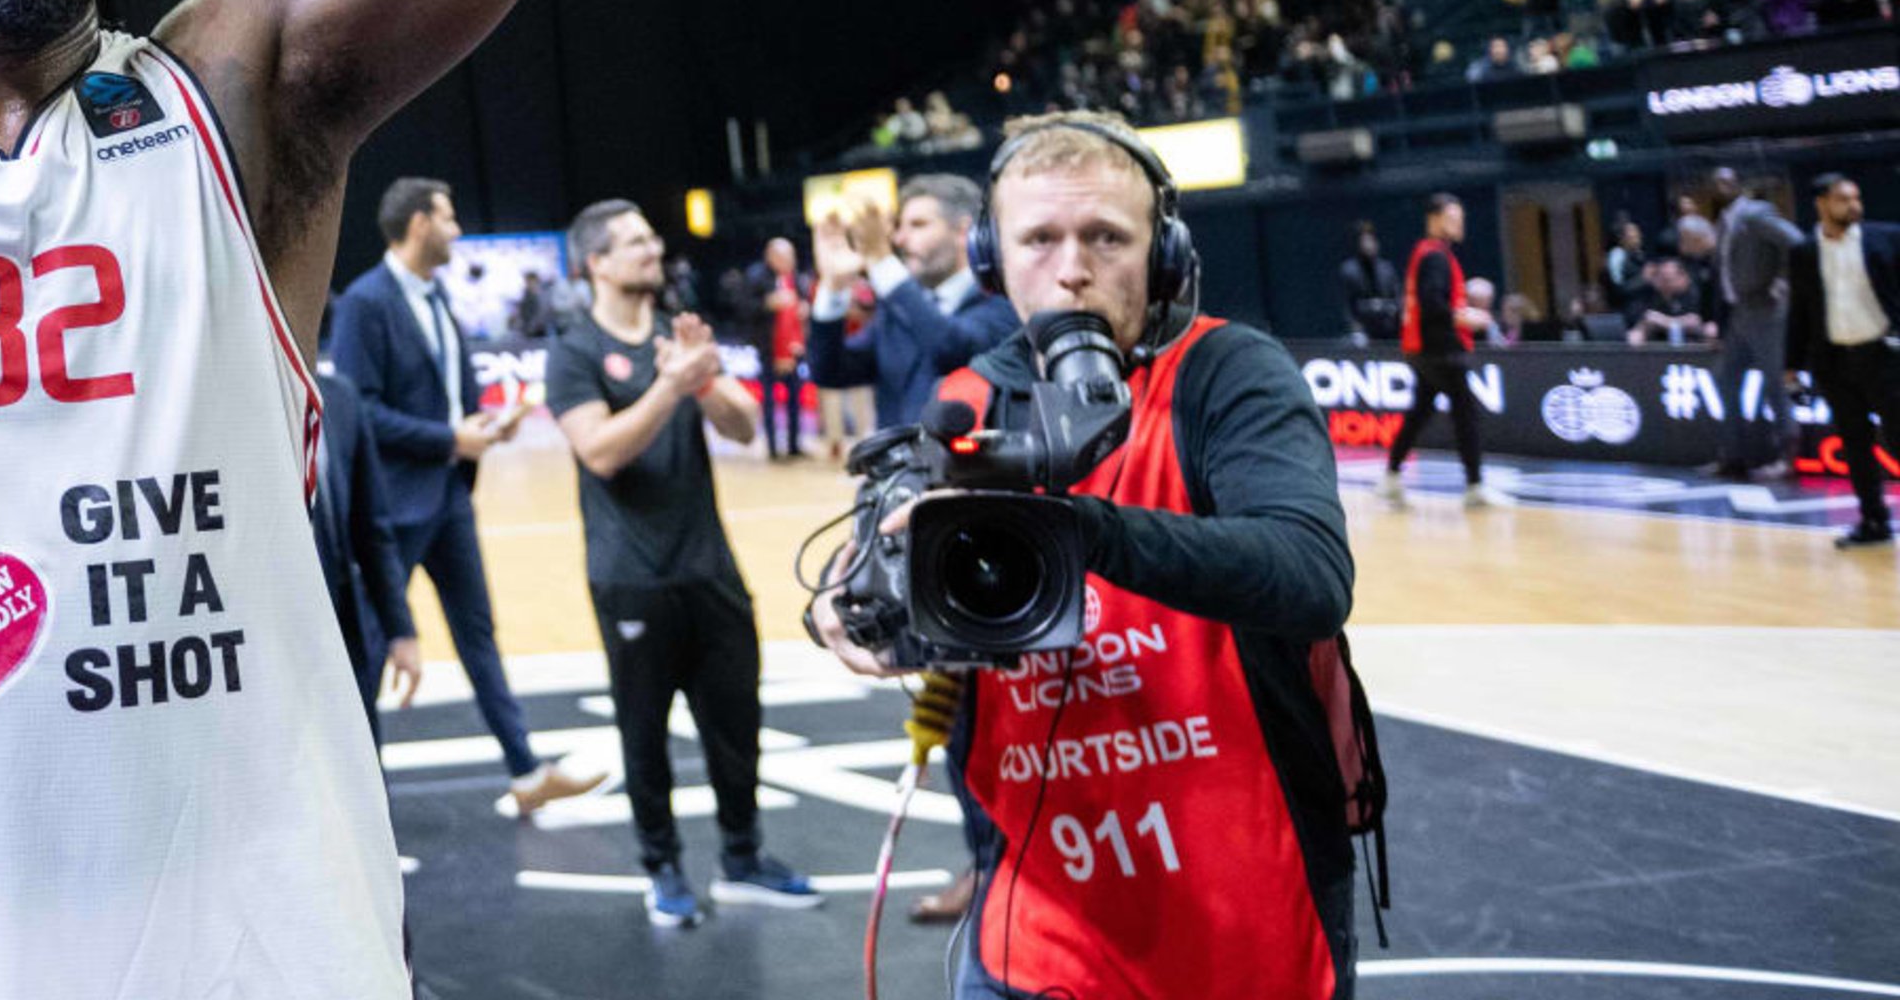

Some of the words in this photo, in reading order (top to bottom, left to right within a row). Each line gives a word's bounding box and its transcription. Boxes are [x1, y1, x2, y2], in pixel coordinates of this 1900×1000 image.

[1648, 81, 1758, 115] LONDON
[1814, 66, 1899, 97] LIONS
[96, 124, 190, 161] oneteam
[1301, 358, 1505, 415] ONDN
[60, 470, 225, 545] GIVE
[87, 559, 155, 627] IT
[179, 553, 225, 616] A
[64, 630, 245, 712] SHOT
[998, 624, 1168, 683] ONDON
[1009, 664, 1143, 713] LIONS
[1051, 802, 1181, 882] 911
